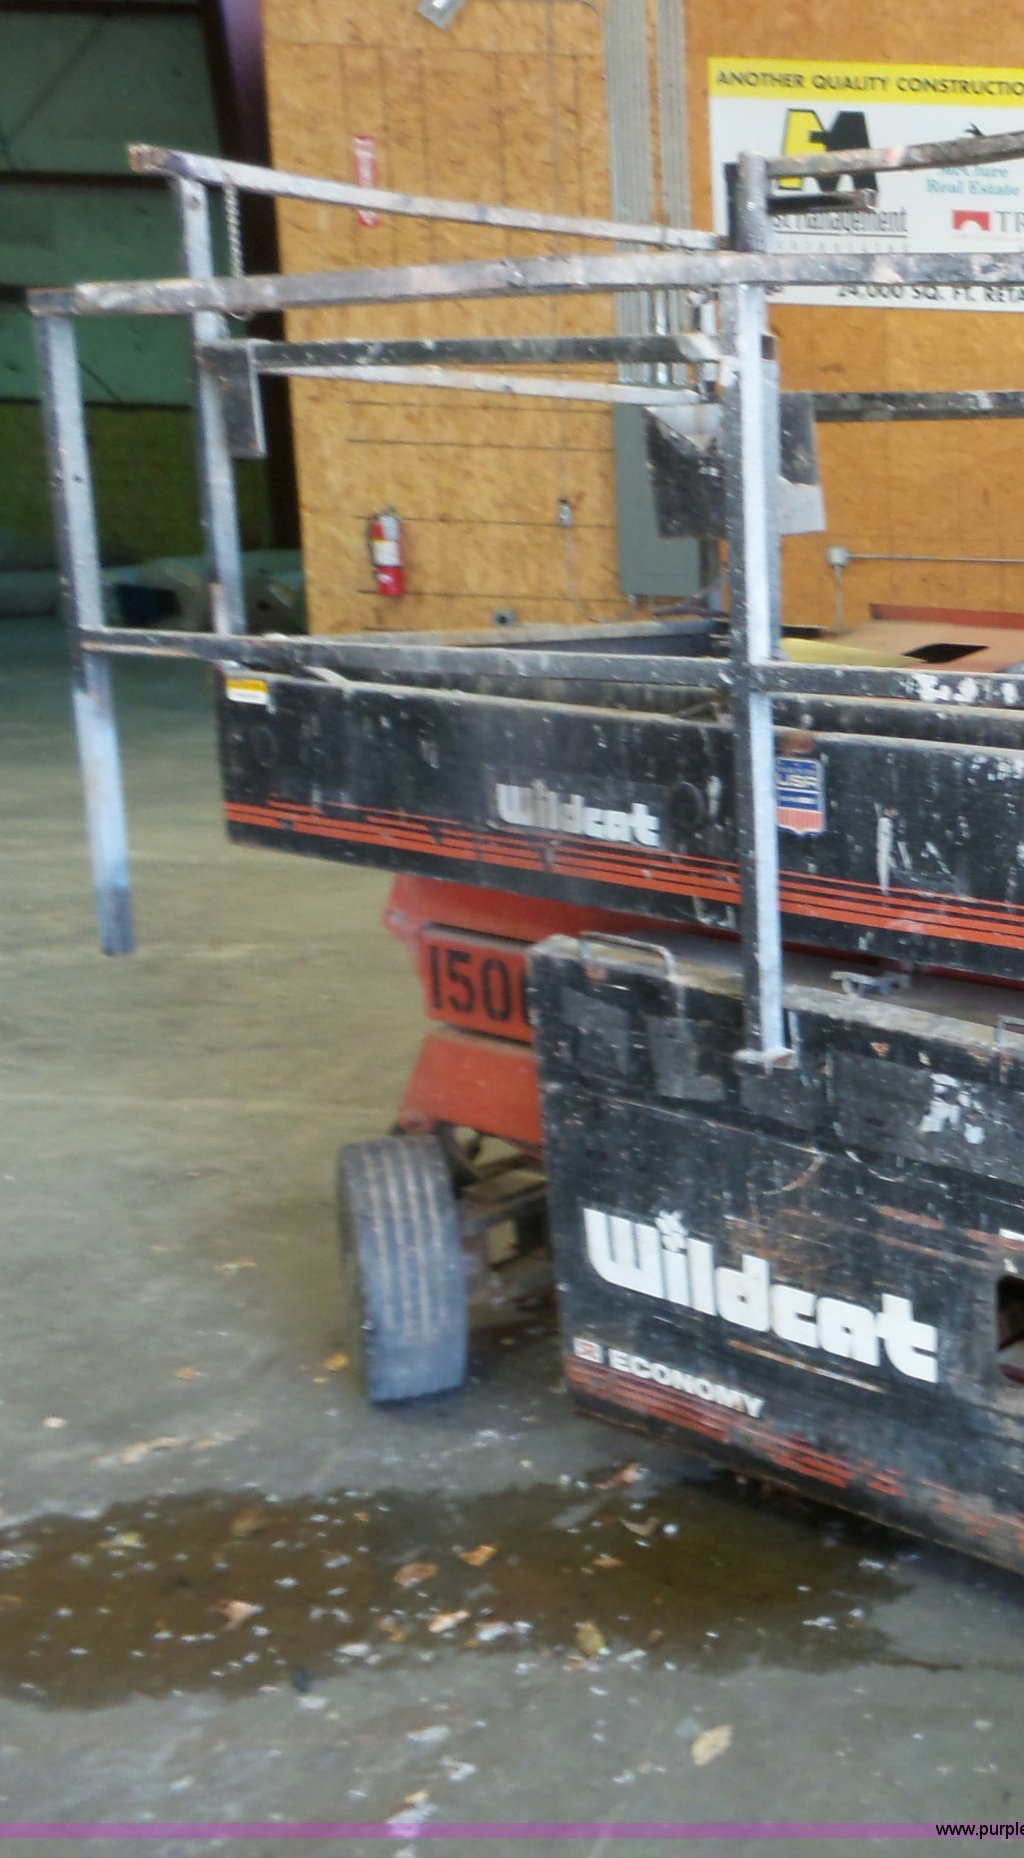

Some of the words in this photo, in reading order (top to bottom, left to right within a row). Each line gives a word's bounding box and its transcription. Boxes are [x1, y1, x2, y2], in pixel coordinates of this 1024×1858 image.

[717, 71, 805, 88] ANOTHER
[811, 74, 889, 91] QUALITY
[495, 779, 660, 848] Wildcat
[429, 944, 530, 1025] 150
[583, 1207, 939, 1384] Wildcat
[607, 1347, 765, 1419] ECONOMY
